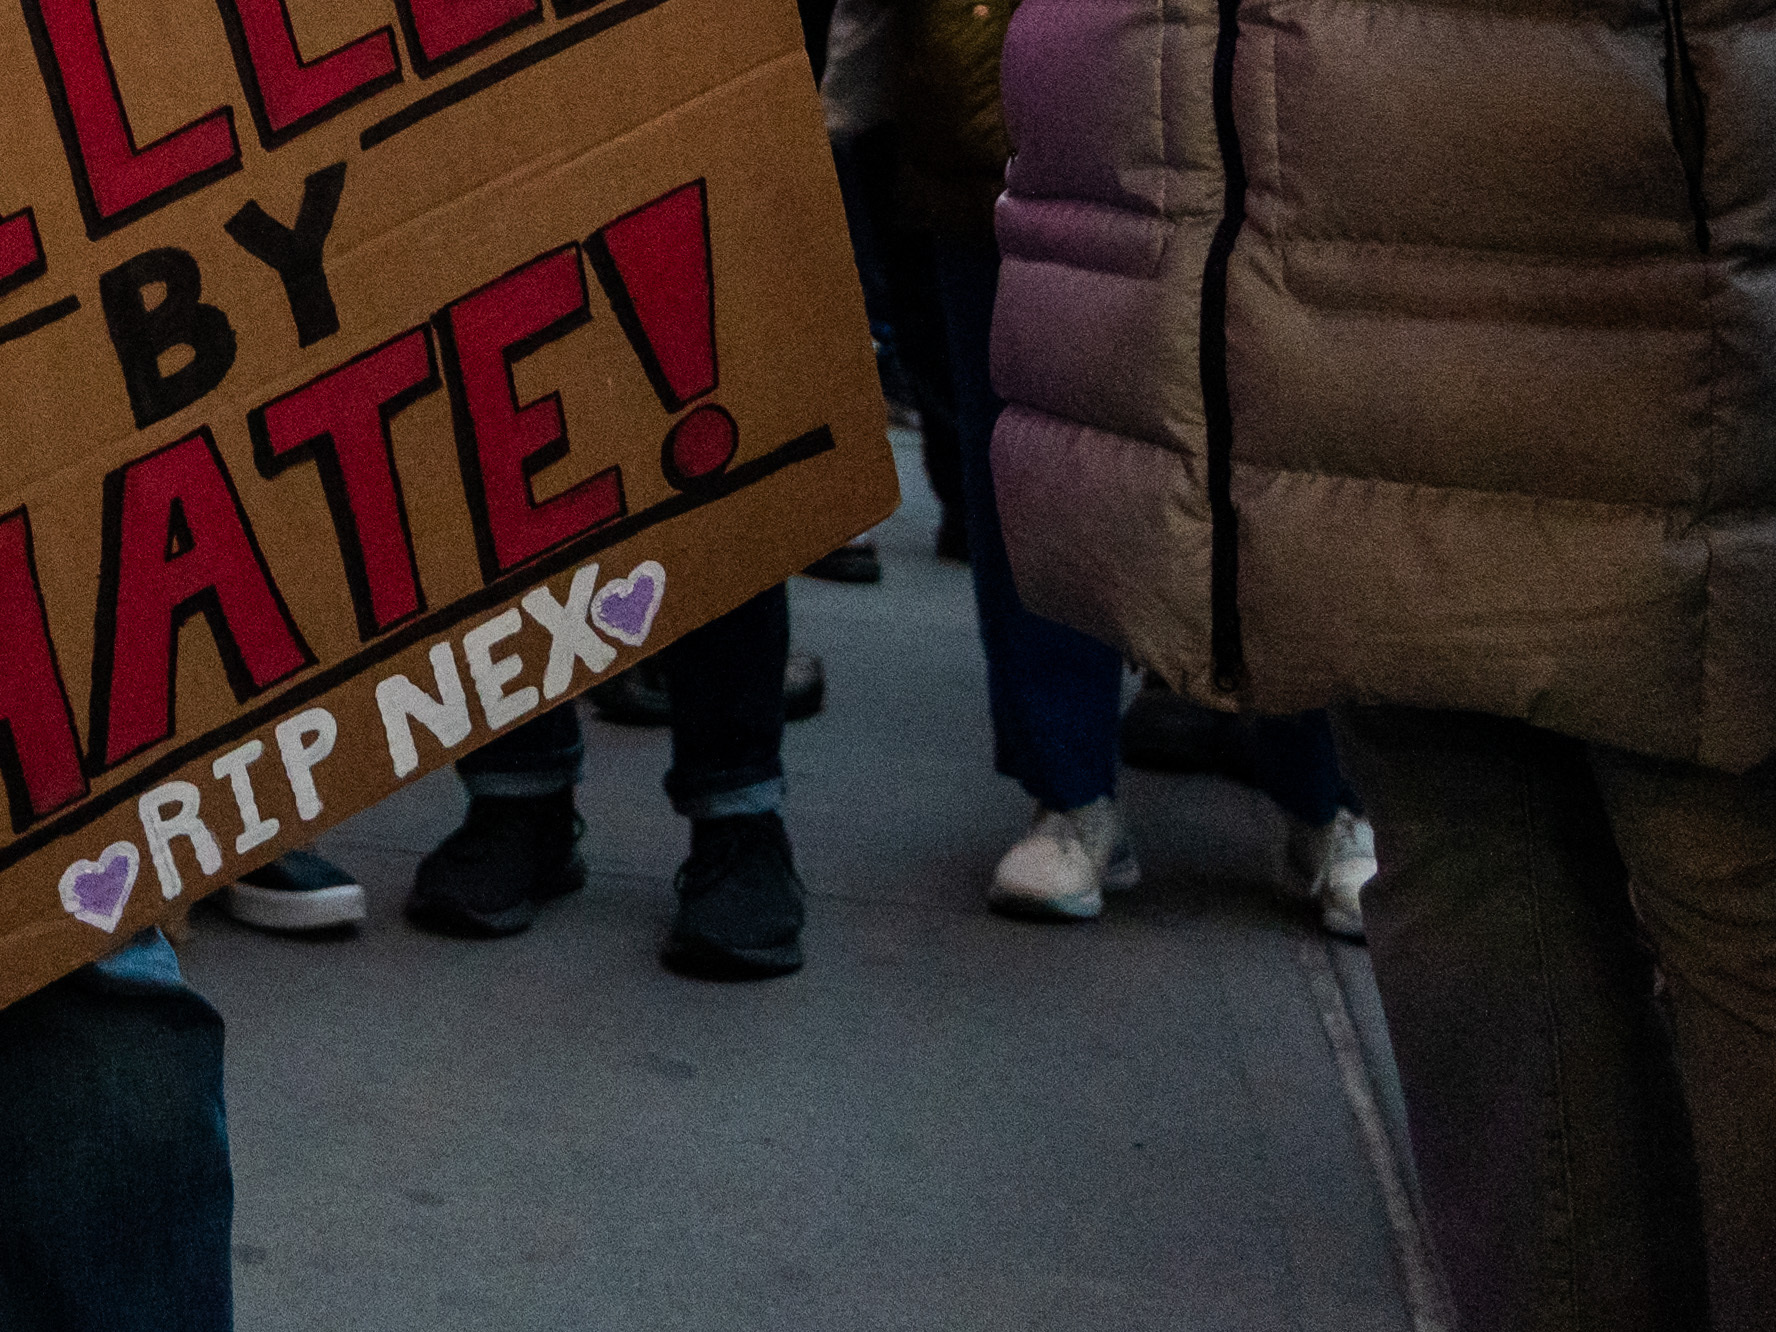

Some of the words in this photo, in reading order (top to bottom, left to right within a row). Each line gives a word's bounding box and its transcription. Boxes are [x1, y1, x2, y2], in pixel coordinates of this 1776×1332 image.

[98, 162, 348, 431] BY
[137, 707, 326, 898] RIP
[374, 563, 618, 779] NEX
